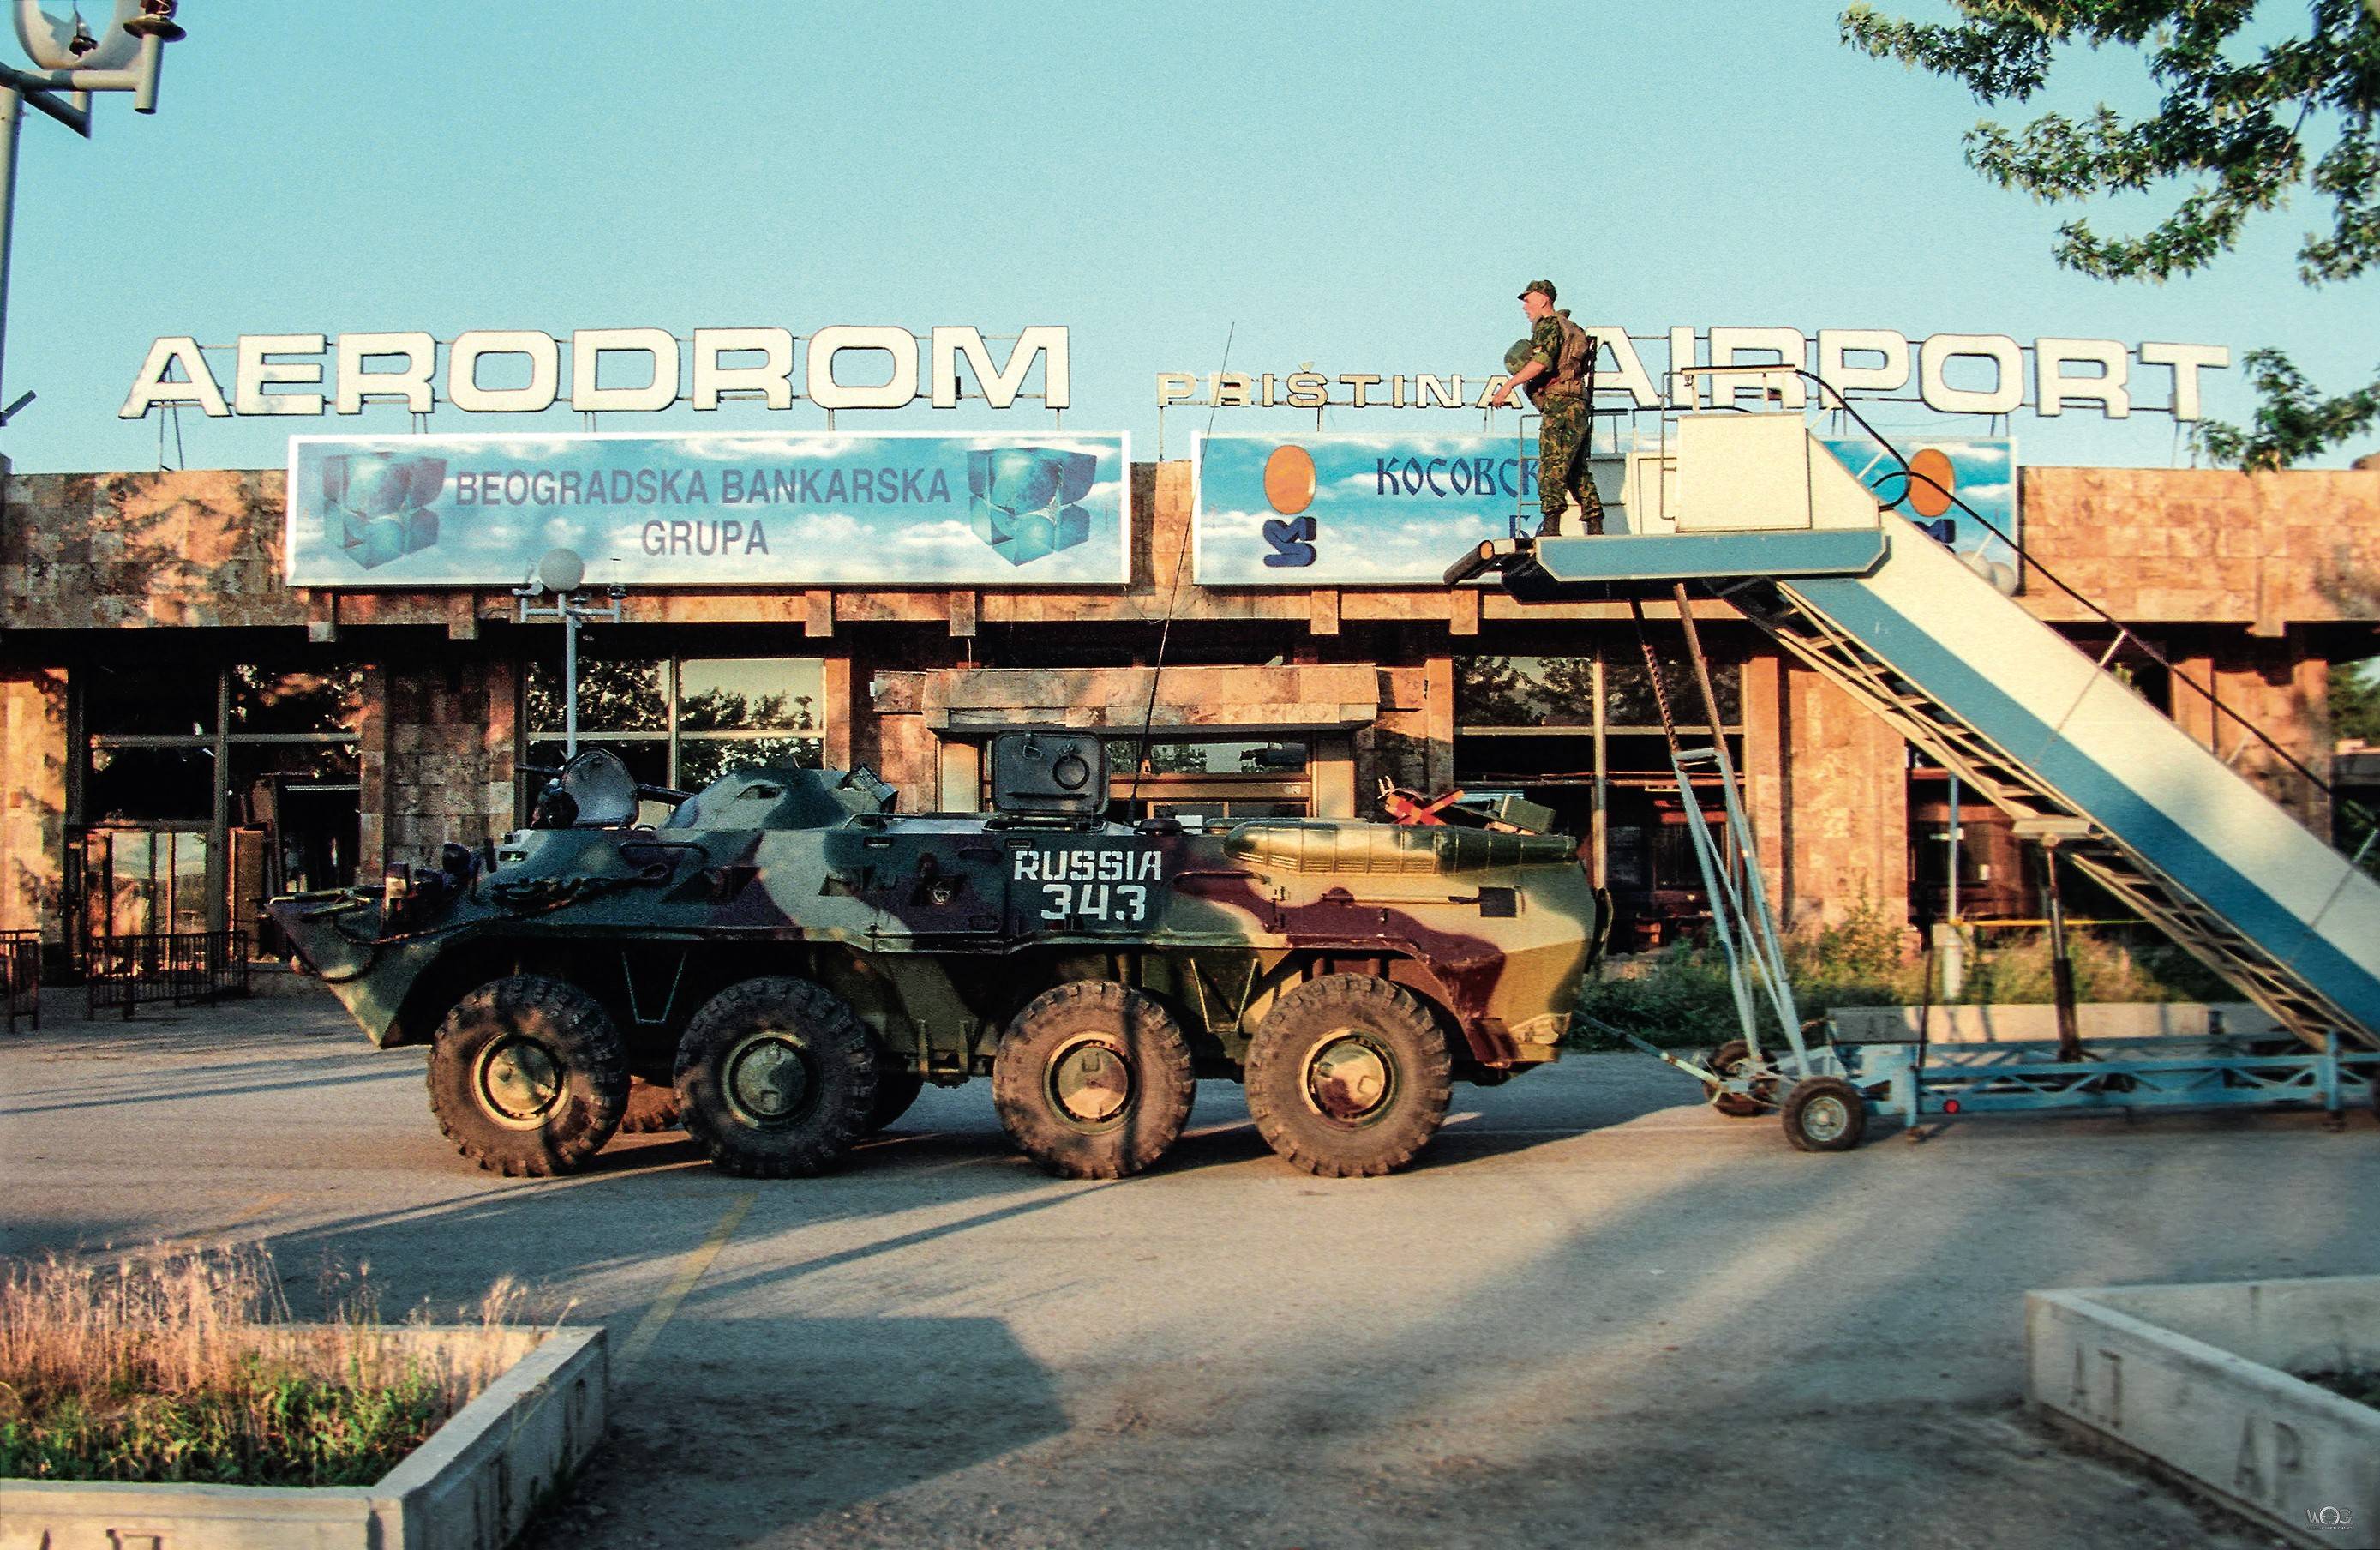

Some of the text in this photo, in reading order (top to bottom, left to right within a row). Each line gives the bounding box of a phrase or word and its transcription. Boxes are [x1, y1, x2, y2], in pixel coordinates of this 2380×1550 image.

[118, 325, 2230, 422] AERODROM PRIŠTINA AIRPORT
[456, 467, 951, 506] BEOGRADSKA BANKARSKA
[1377, 456, 1540, 499] КОСОВСК
[643, 519, 769, 556] GRUPA
[1014, 850, 1162, 881] RUSSIA
[1040, 884, 1147, 921] 343
